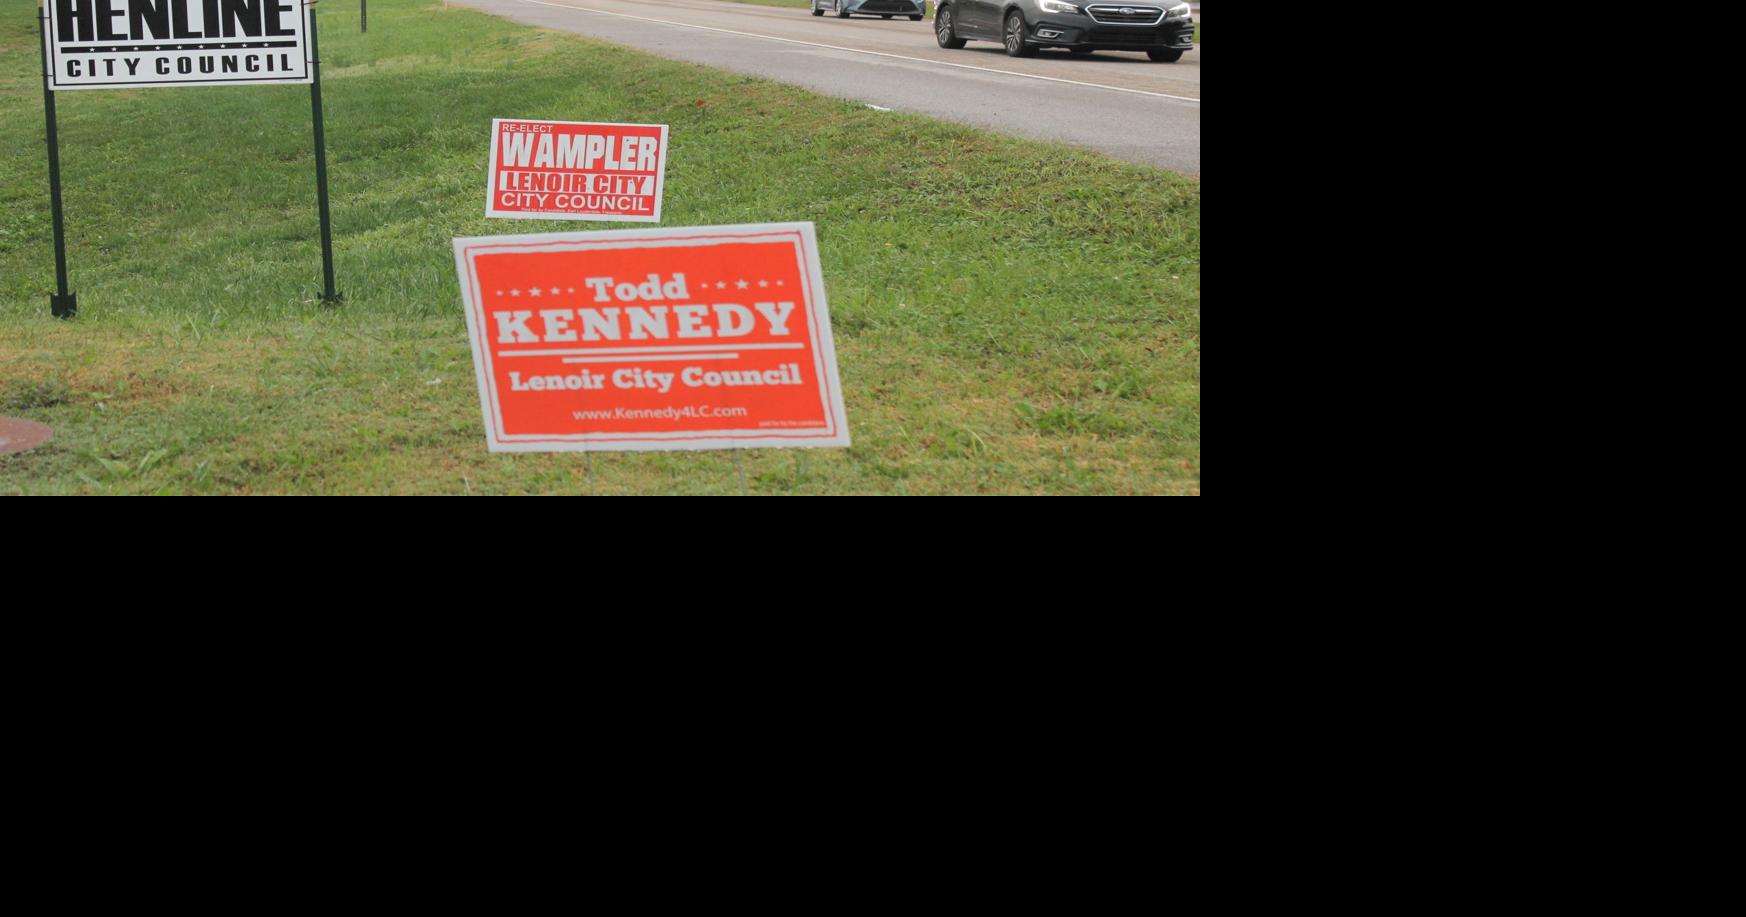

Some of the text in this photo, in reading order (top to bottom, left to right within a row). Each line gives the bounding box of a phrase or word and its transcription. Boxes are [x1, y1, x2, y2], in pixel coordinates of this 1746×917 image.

[57, 0, 296, 42] HENLINE
[66, 53, 294, 77] CITY COUNCIL
[502, 124, 553, 132] RE-ELECT
[502, 132, 658, 171] WAMPLER
[506, 172, 646, 195] LENOIR CITY
[501, 193, 548, 207] CITY
[555, 195, 650, 211] COUNCIL
[585, 273, 690, 302] Todd
[493, 301, 795, 344] KENNEDY
[509, 363, 803, 393] Lenoir City Council
[572, 405, 748, 422] www.Kennedy4LC.com
